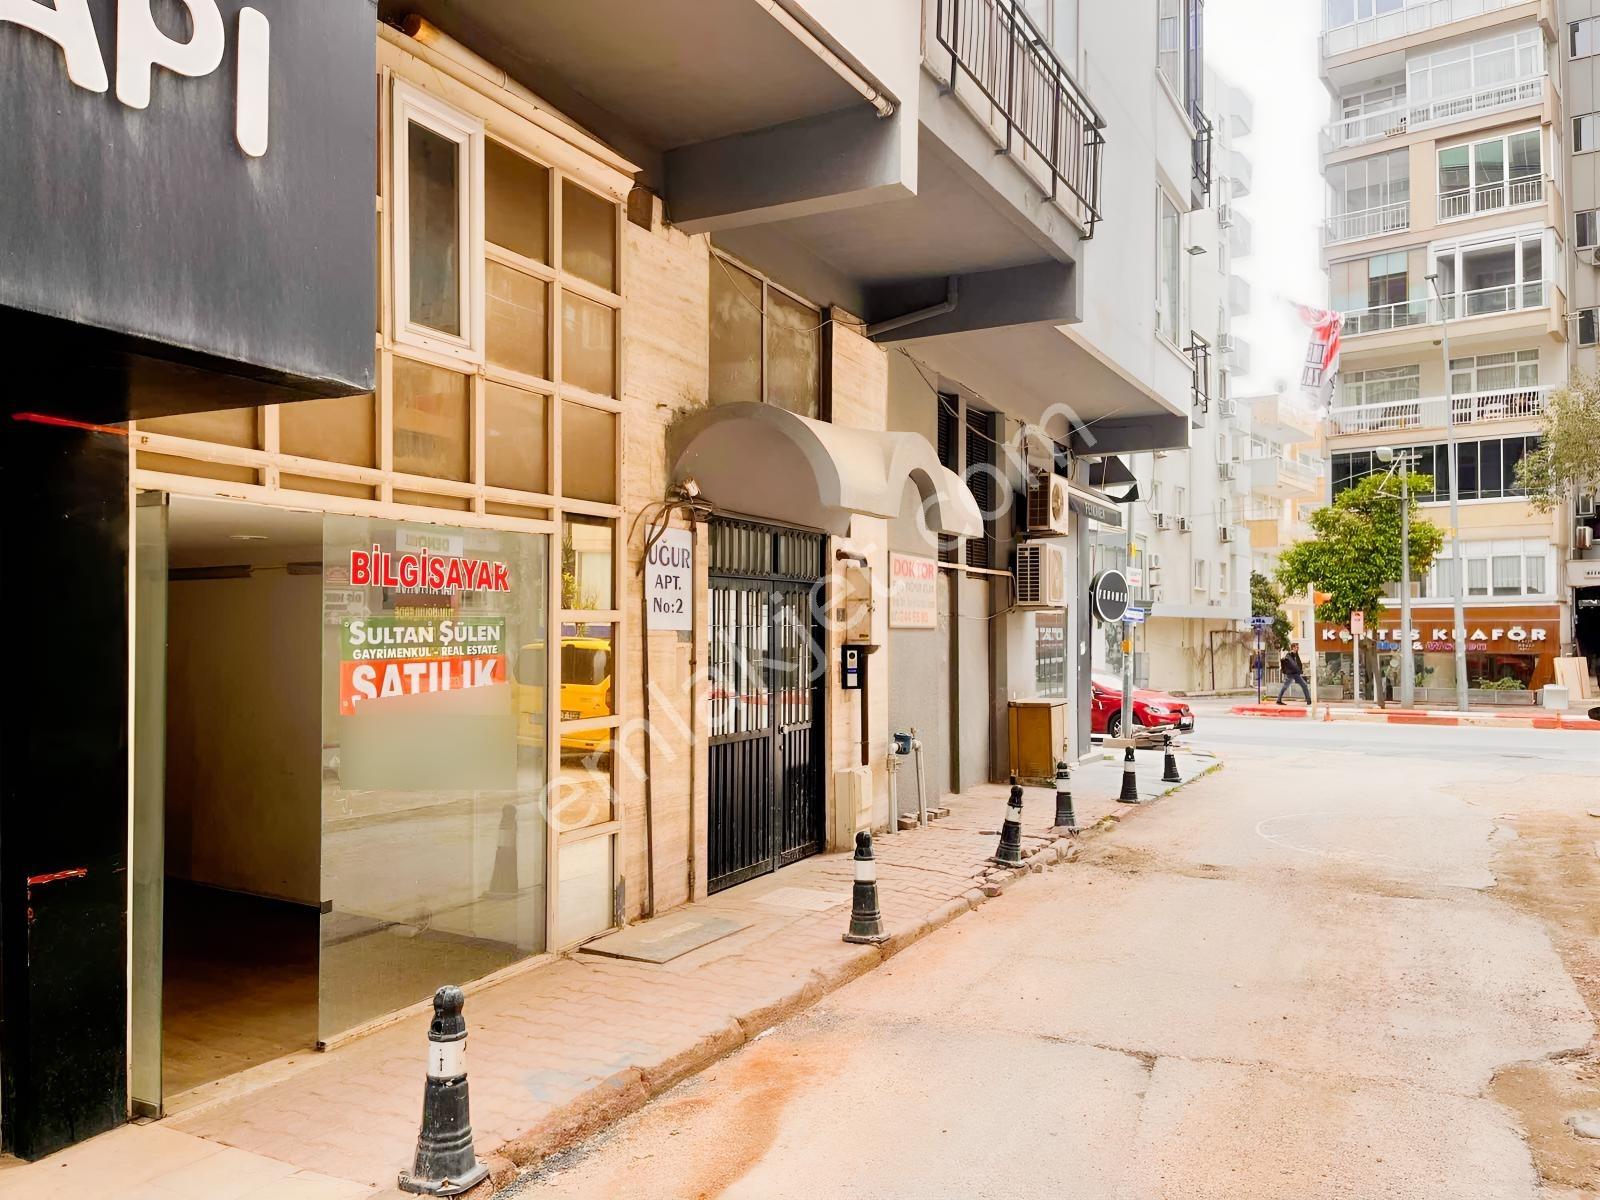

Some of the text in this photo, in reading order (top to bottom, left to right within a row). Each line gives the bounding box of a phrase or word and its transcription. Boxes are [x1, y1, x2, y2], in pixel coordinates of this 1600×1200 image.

[648, 539, 690, 569] UĞUR
[350, 543, 511, 592] BİLGİSAYAR
[655, 574, 682, 591] APT.
[653, 597, 684, 614] No:2
[349, 620, 500, 645] SULTAN ŞÜLEN
[352, 645, 431, 660] GAYRİMENKUL
[441, 646, 464, 656] REAL
[467, 645, 498, 655] ESTATE
[1426, 641, 1487, 651] Woen
